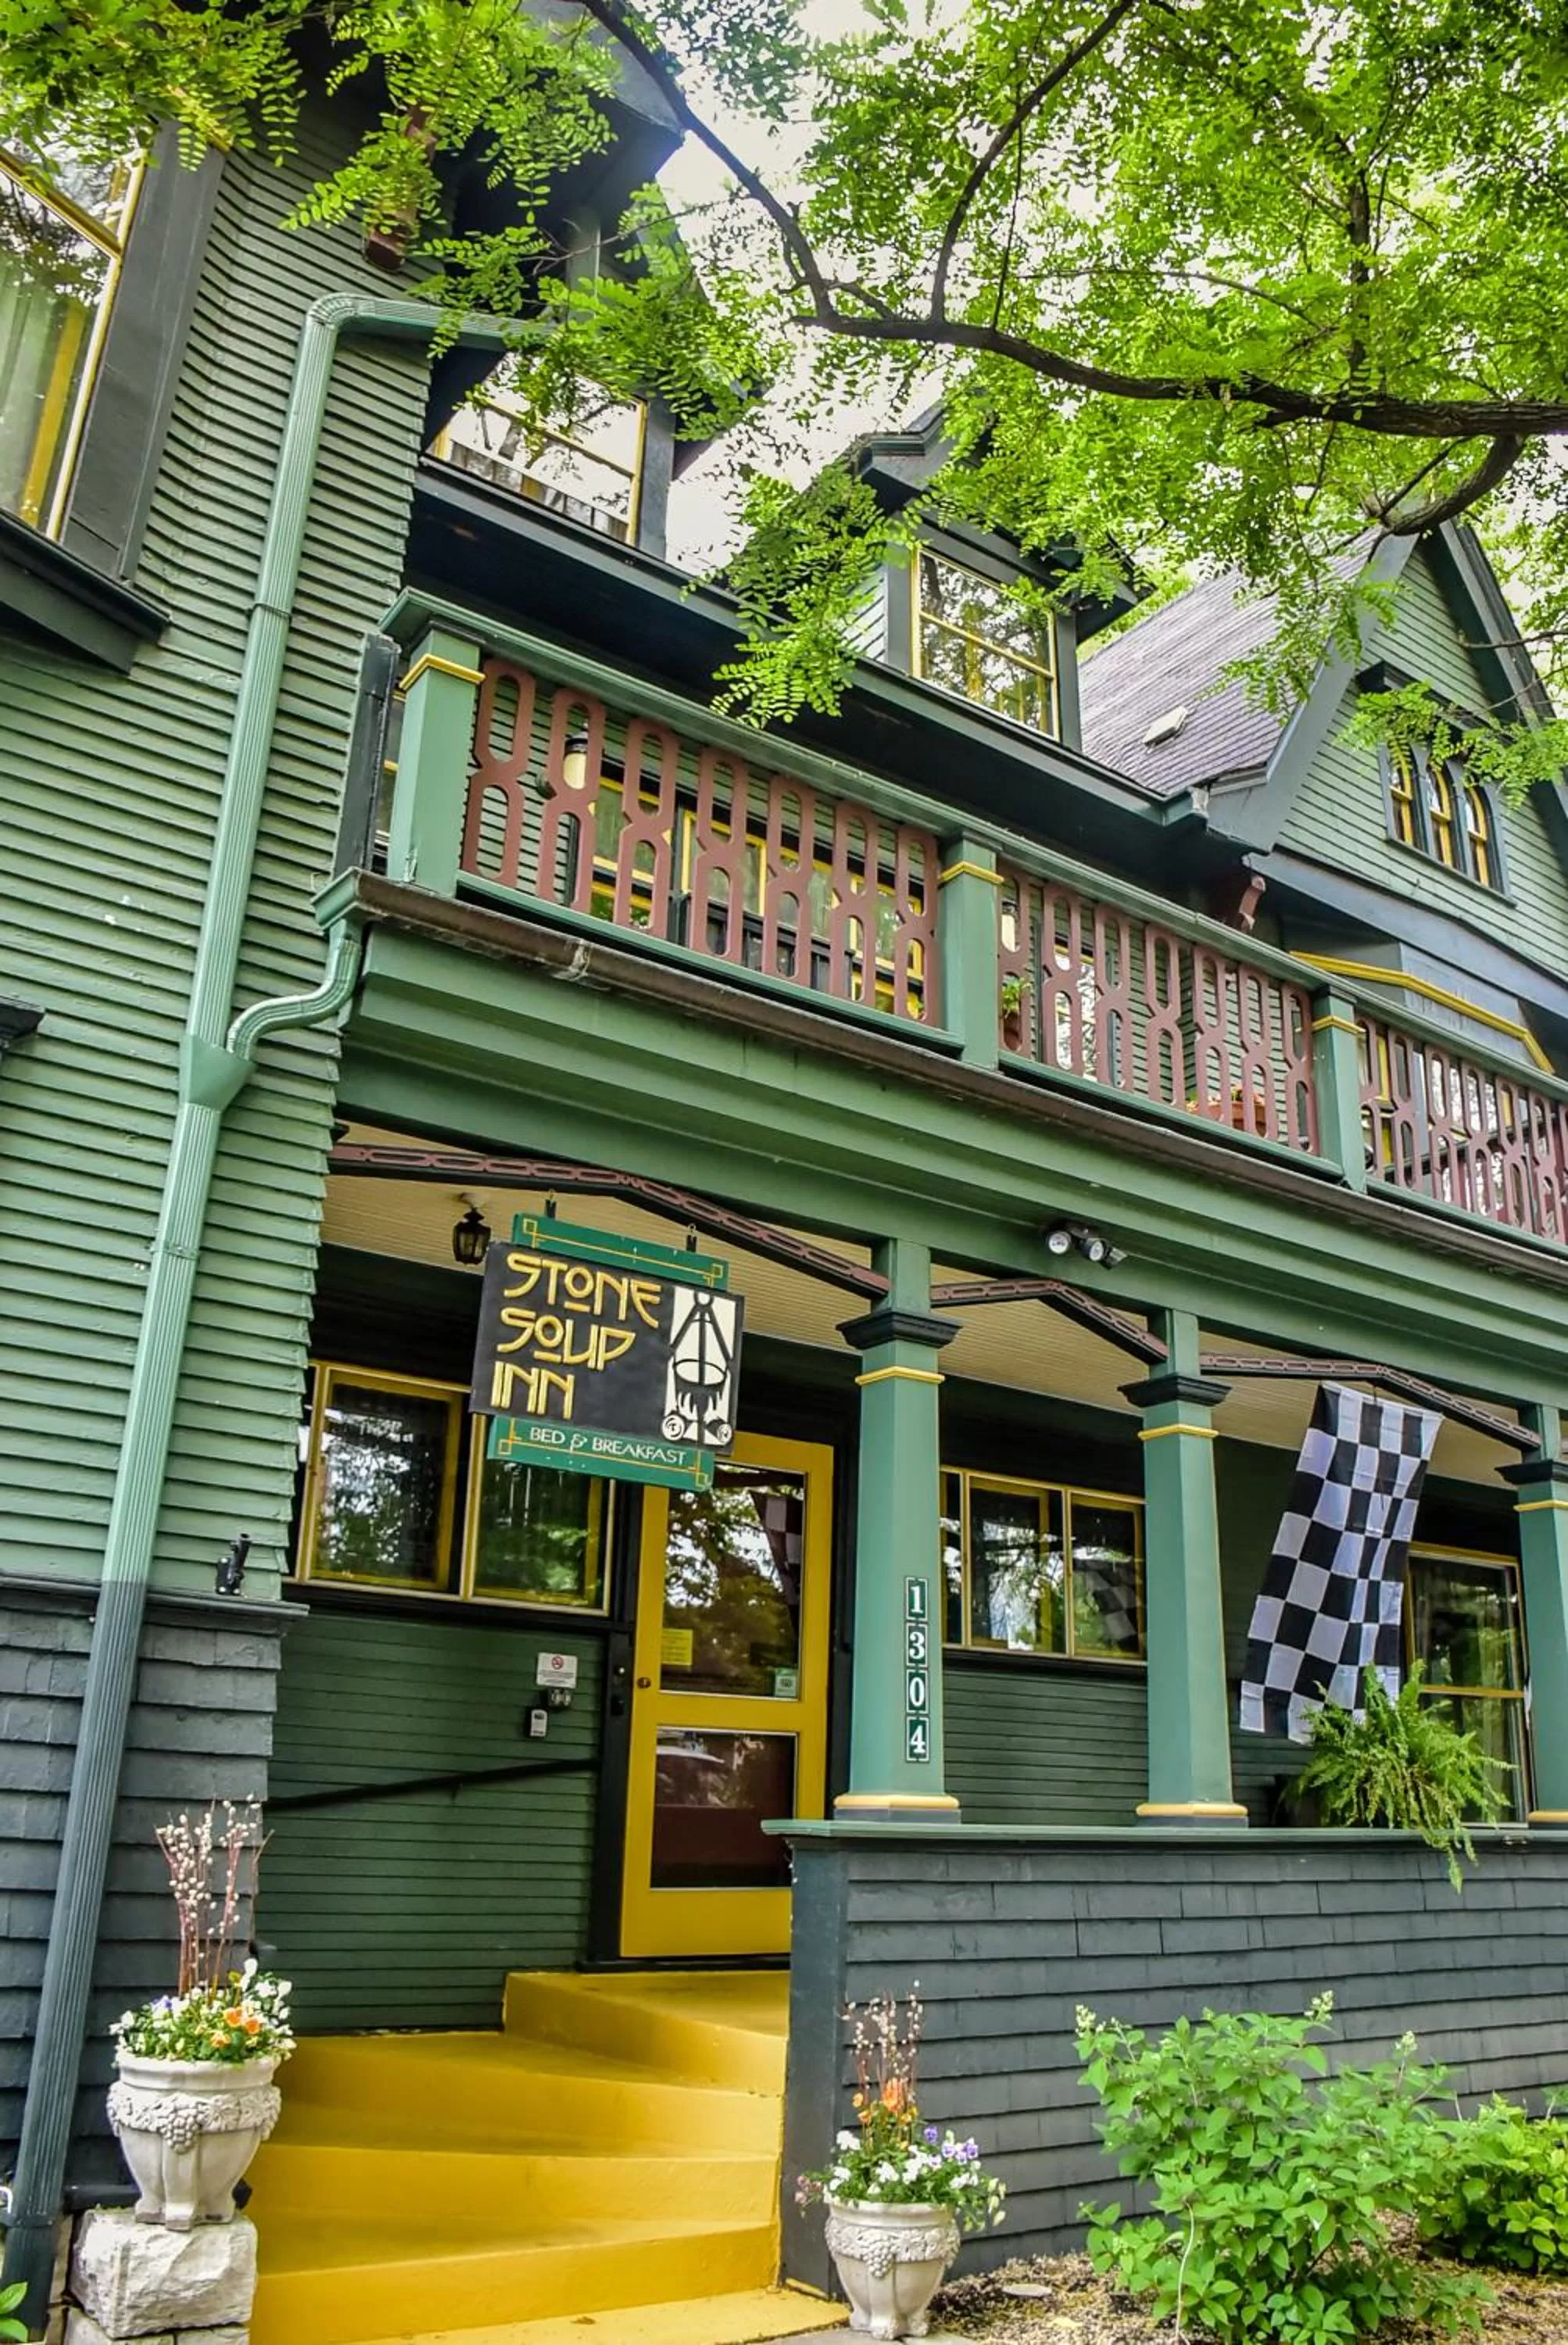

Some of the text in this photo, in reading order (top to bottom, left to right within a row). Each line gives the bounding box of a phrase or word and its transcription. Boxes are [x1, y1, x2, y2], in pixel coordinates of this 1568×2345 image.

[504, 1252, 662, 1328] STONE
[497, 1307, 636, 1370] SOUP
[490, 1361, 575, 1420] INN
[529, 1427, 687, 1465] BED & BREAKFAST
[908, 1584, 926, 1754] 1304
